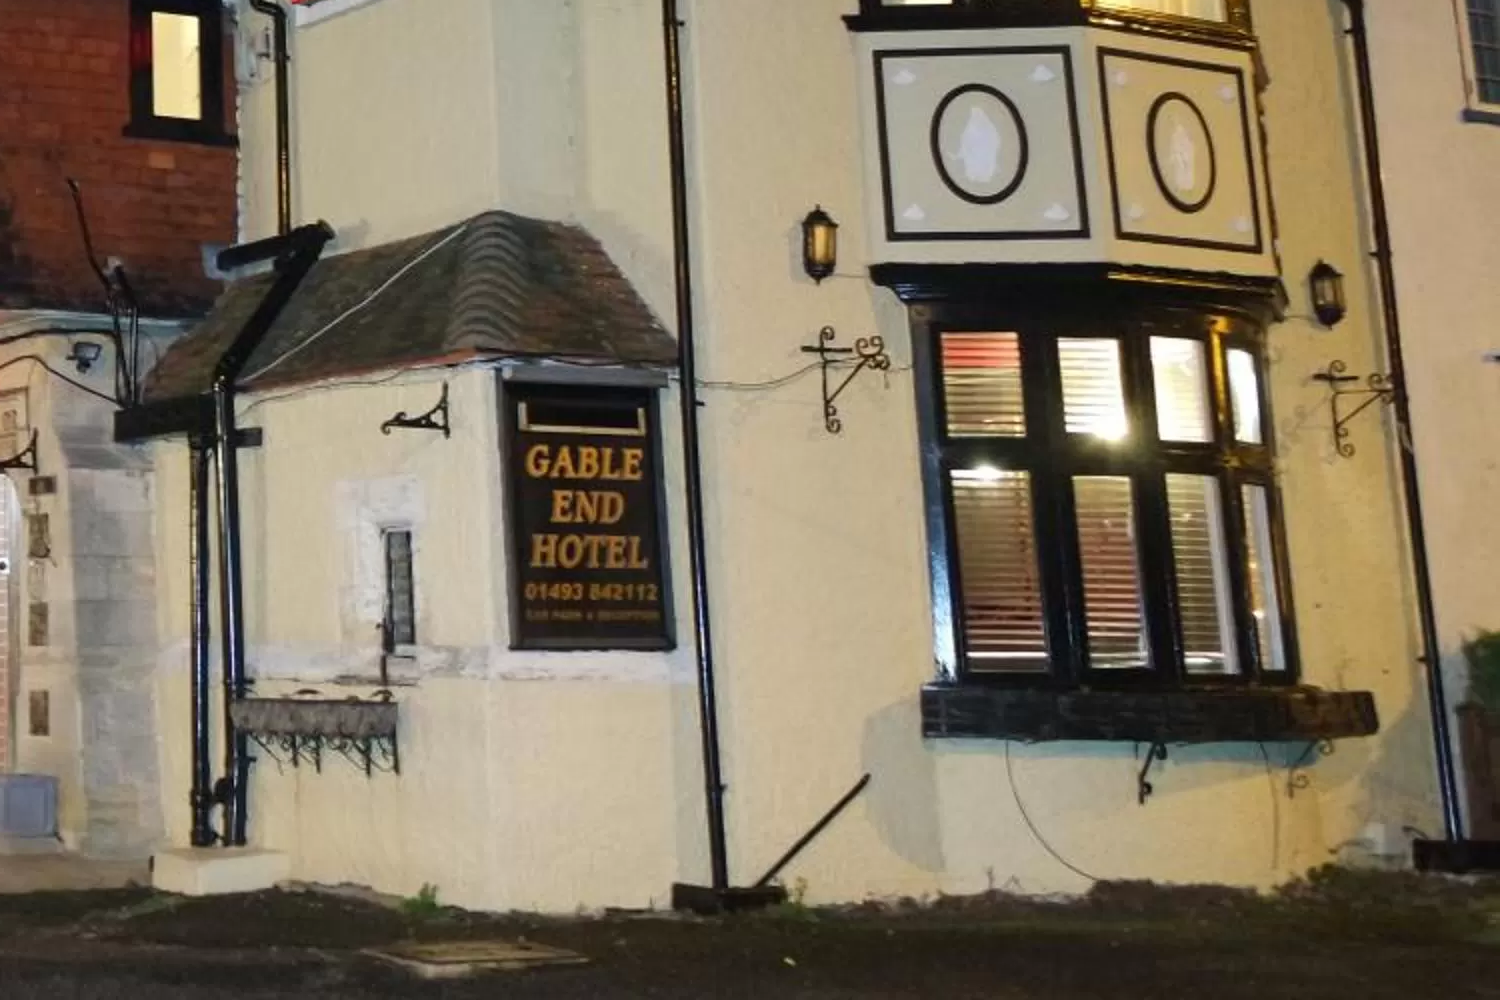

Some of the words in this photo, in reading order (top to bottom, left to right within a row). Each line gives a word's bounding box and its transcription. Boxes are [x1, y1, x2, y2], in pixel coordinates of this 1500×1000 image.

[526, 445, 643, 480] GABLE
[551, 490, 625, 524] END
[529, 534, 648, 569] HOTEL
[525, 582, 583, 600] 01493
